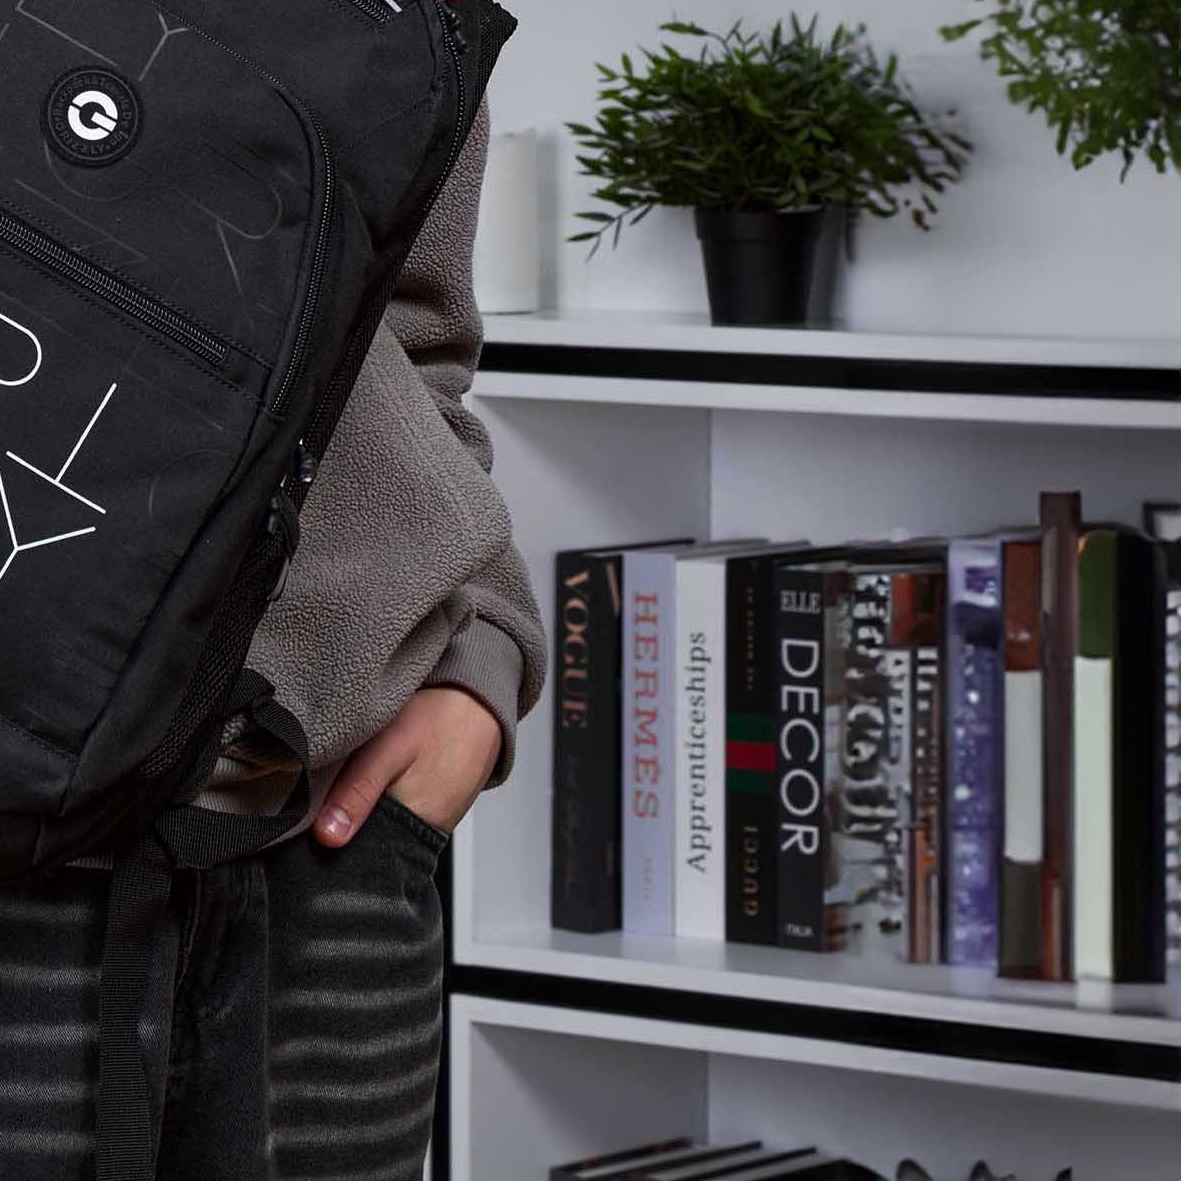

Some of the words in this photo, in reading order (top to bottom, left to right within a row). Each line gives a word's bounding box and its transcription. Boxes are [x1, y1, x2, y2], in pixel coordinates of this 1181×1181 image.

[563, 570, 590, 728] VOGUE
[780, 590, 820, 613] ELLE
[685, 631, 712, 873] Apprenticeships
[779, 639, 820, 855] DECOR
[742, 825, 759, 916] GUCCI
